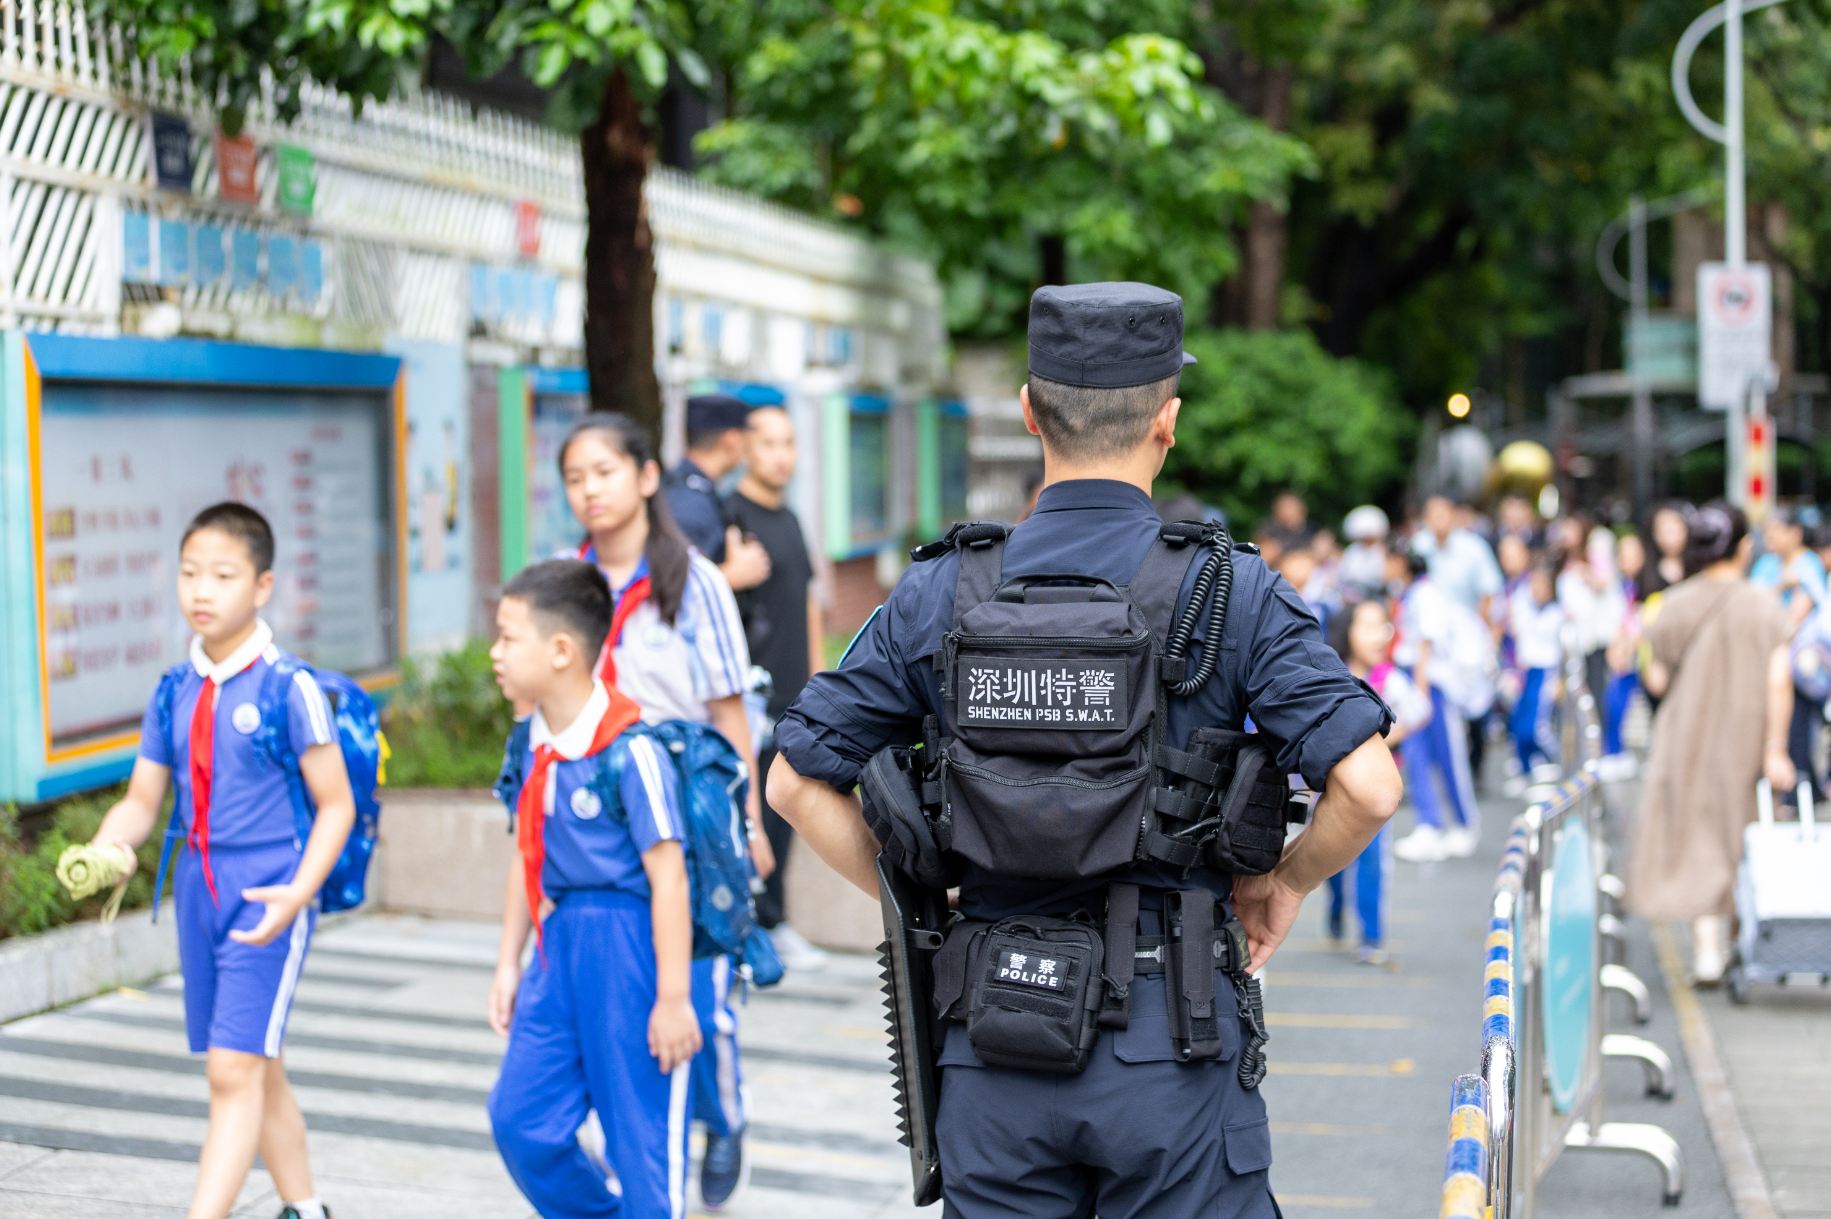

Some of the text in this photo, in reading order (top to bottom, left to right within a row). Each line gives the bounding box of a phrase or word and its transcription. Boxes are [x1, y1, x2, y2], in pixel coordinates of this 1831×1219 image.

[968, 667, 1115, 706] 深圳特警
[968, 706, 1115, 722] SHENZHEN PSB S.W.A.T.
[1010, 953, 1057, 975] 警察
[1001, 968, 1059, 987] POLICE
